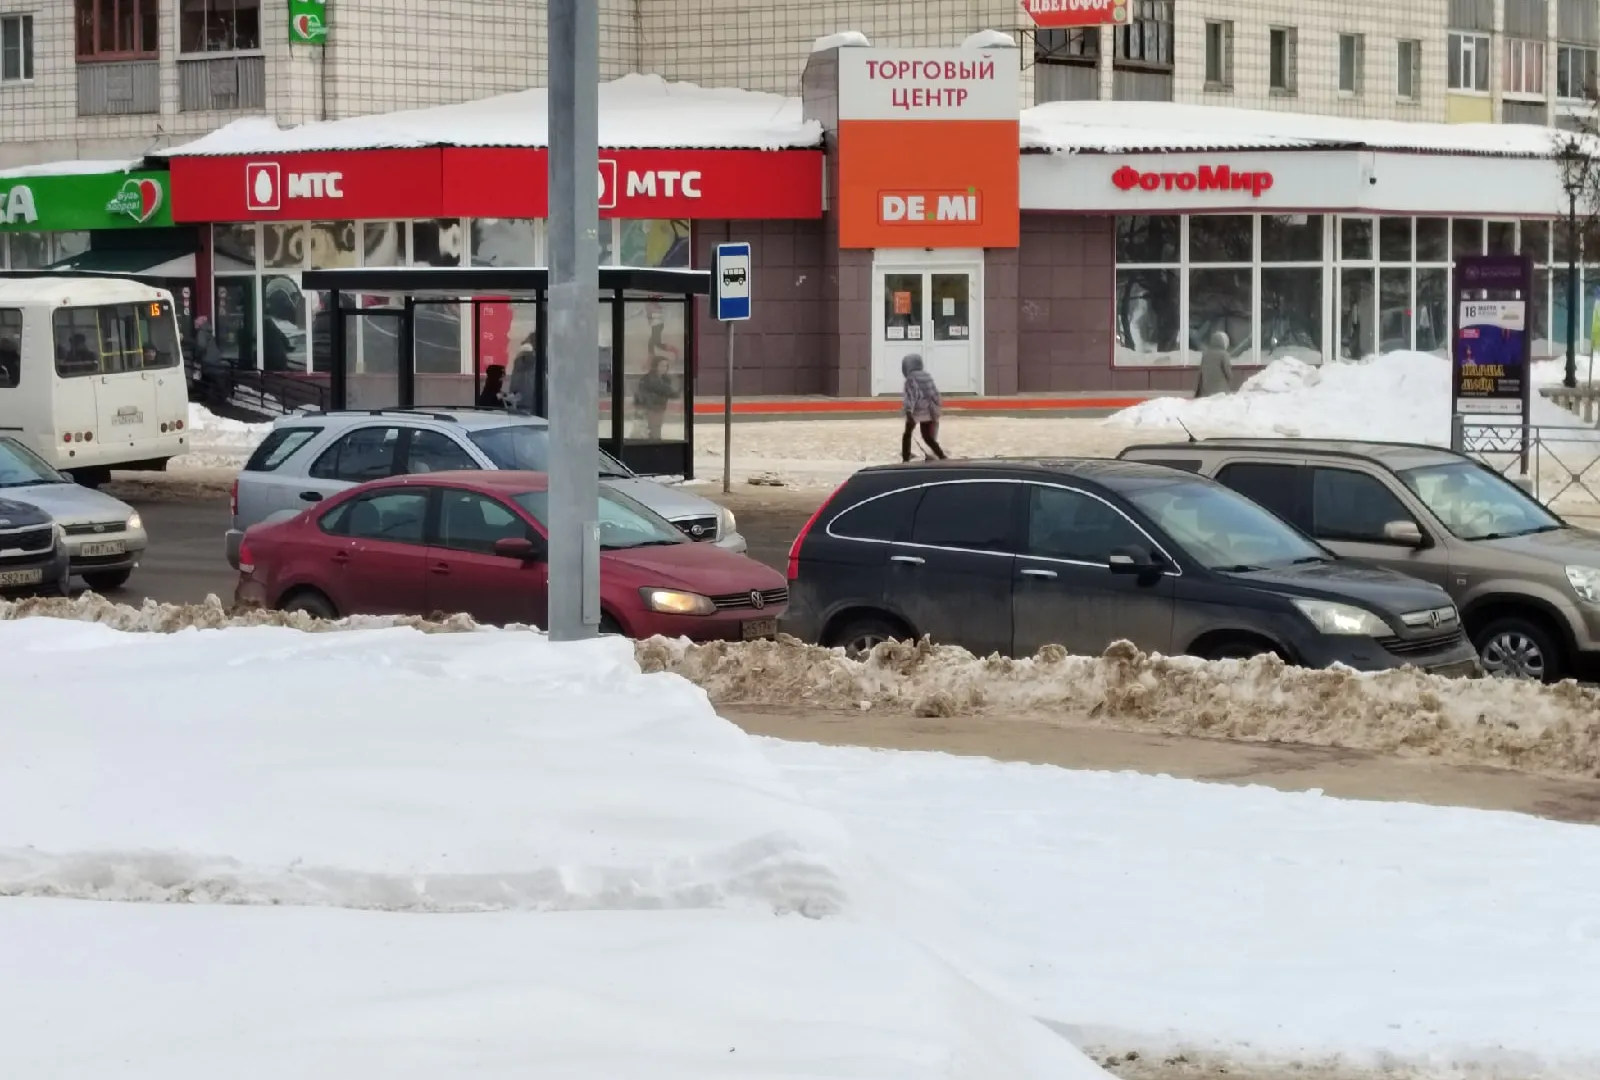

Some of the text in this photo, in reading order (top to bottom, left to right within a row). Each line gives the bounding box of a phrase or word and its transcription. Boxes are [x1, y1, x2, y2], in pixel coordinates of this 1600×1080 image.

[865, 54, 995, 80] ТОРГОВЫЙ
[891, 87, 969, 111] ЦЕНТР
[287, 171, 344, 199] МТС
[626, 170, 702, 198] МТС
[1111, 164, 1274, 198] ФотоМир
[151, 303, 160, 316] 15
